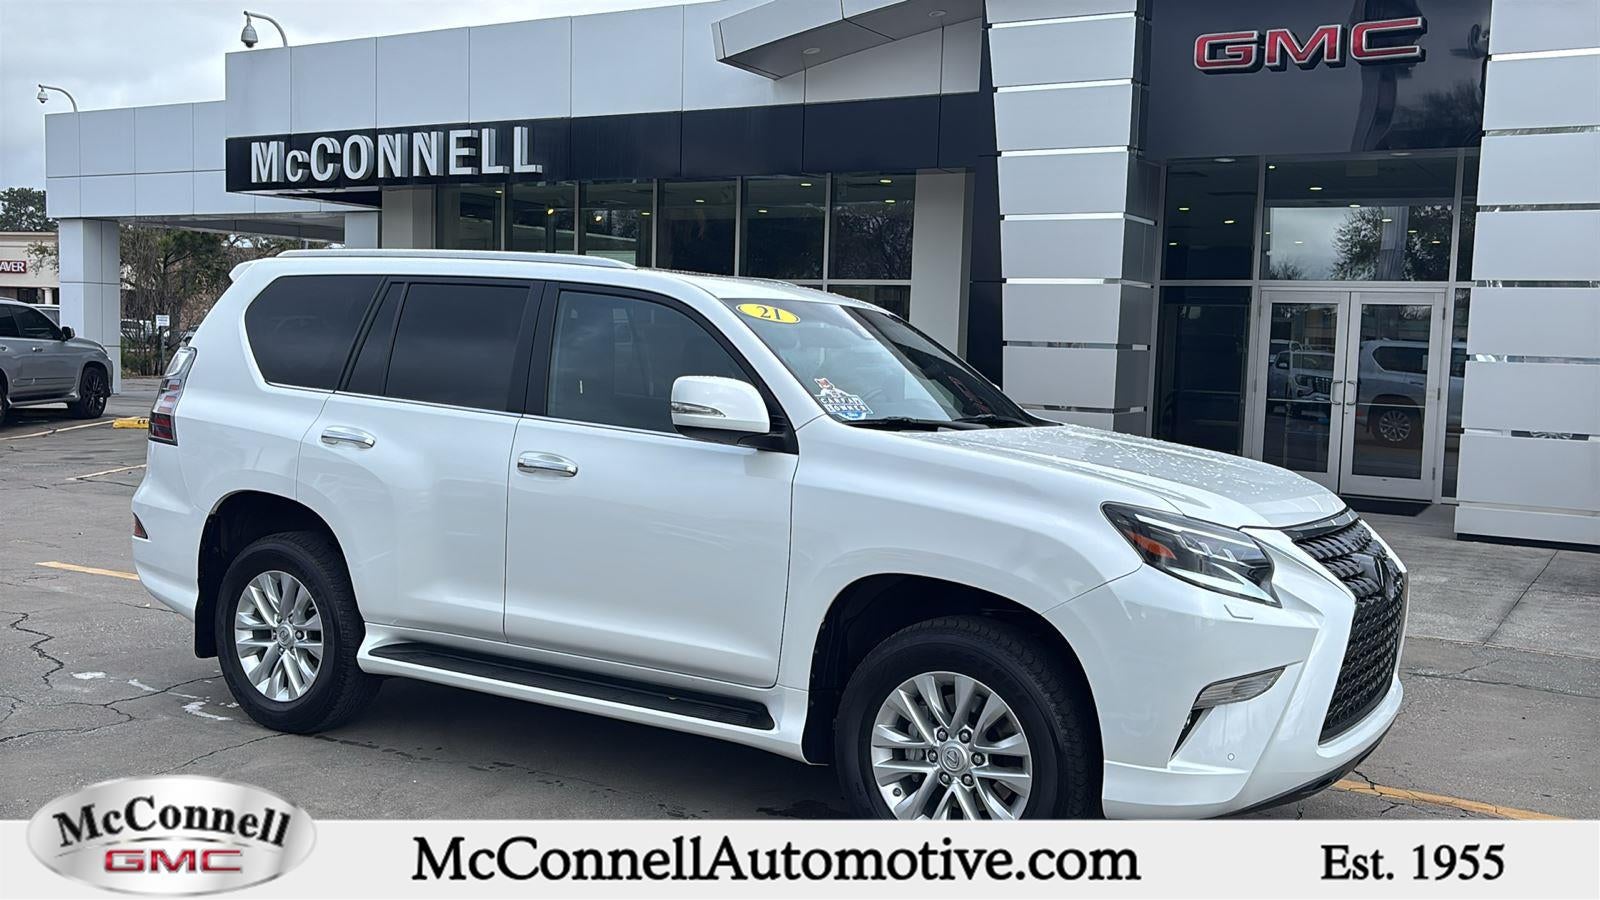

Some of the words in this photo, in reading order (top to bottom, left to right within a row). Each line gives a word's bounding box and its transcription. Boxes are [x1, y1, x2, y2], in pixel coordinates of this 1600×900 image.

[1194, 16, 1427, 74] GMC
[250, 126, 543, 184] McCONNELL
[756, 305, 781, 320] 21
